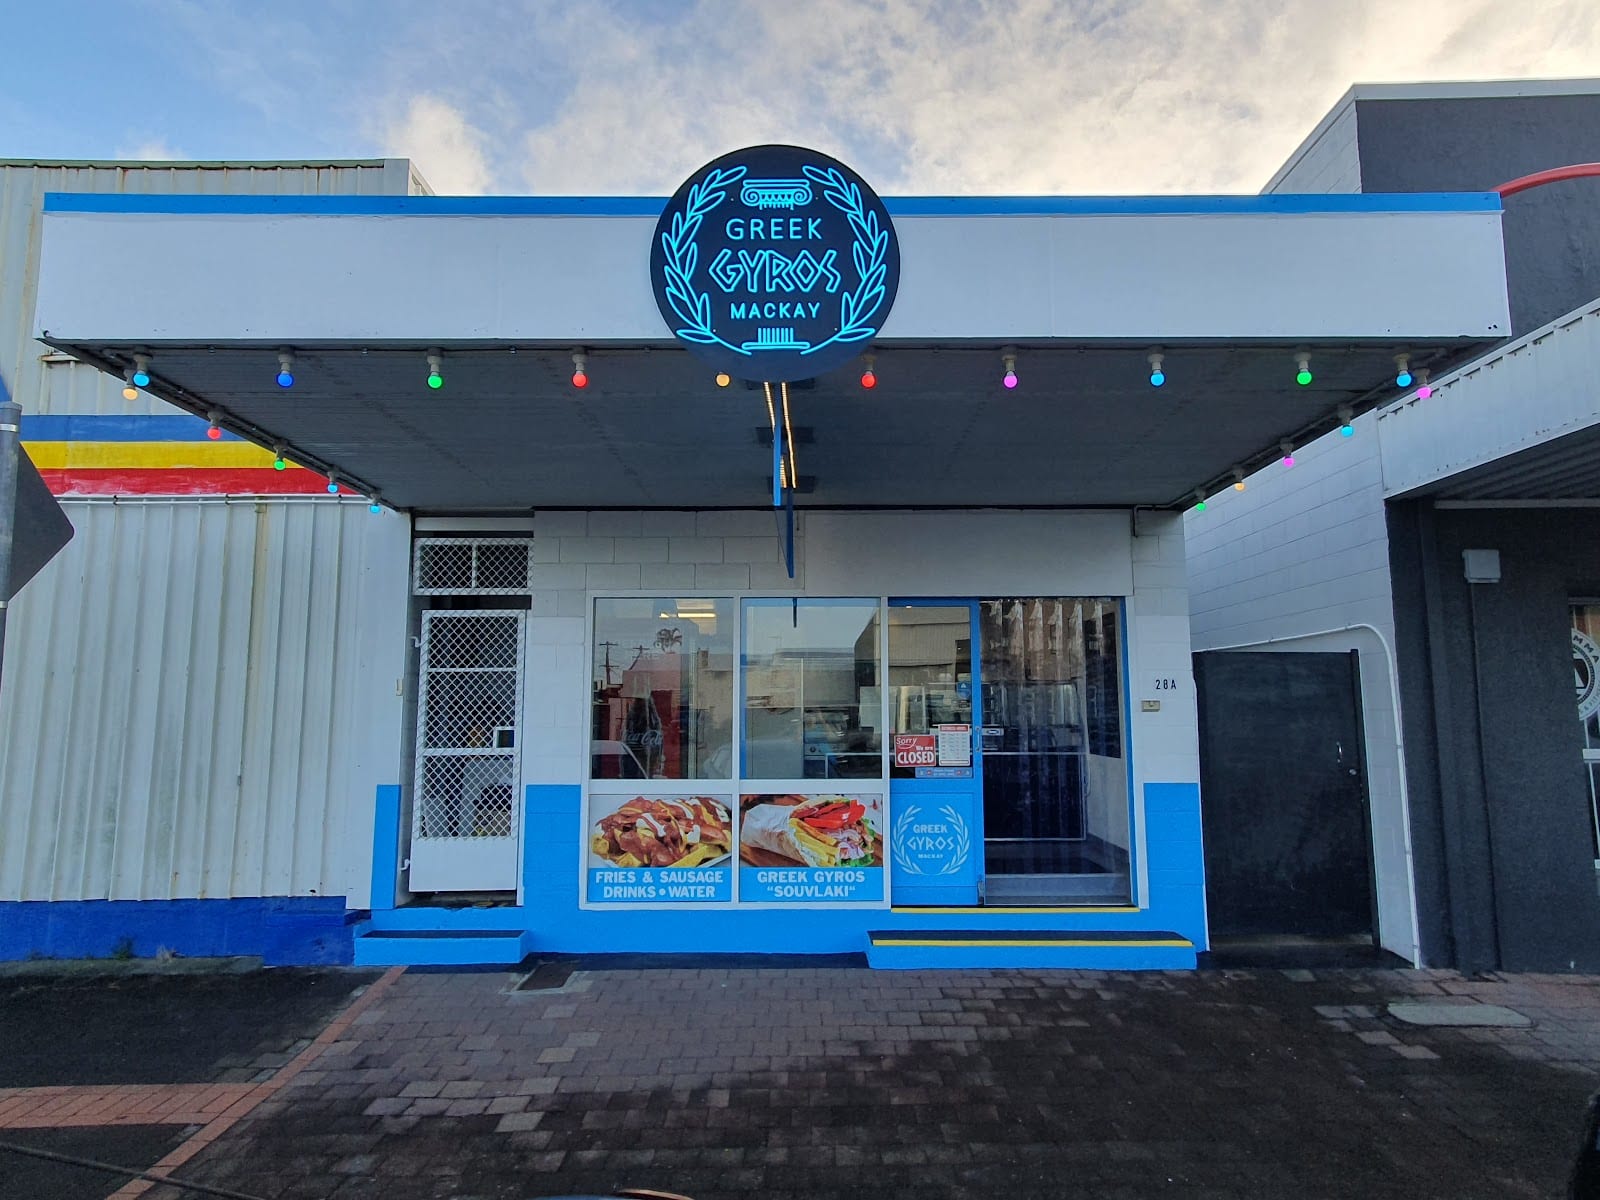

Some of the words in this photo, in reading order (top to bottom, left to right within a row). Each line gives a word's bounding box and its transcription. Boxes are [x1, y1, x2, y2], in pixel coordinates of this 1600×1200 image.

[726, 218, 822, 240] GREEK
[709, 249, 841, 292] GYROS
[730, 302, 820, 319] MACKAY
[1155, 679, 1177, 690] 28A
[896, 737, 918, 749] Sorry
[897, 751, 935, 764] CLOSED
[913, 823, 948, 834] GREEK
[906, 836, 955, 851] GYROS
[595, 871, 636, 884] FRIES
[642, 871, 654, 884] &
[660, 871, 724, 884] SAUSAGE
[757, 871, 808, 883] GREEK
[814, 871, 865, 883] GYROS
[603, 885, 656, 898] DRINKS
[668, 885, 716, 898] WATER
